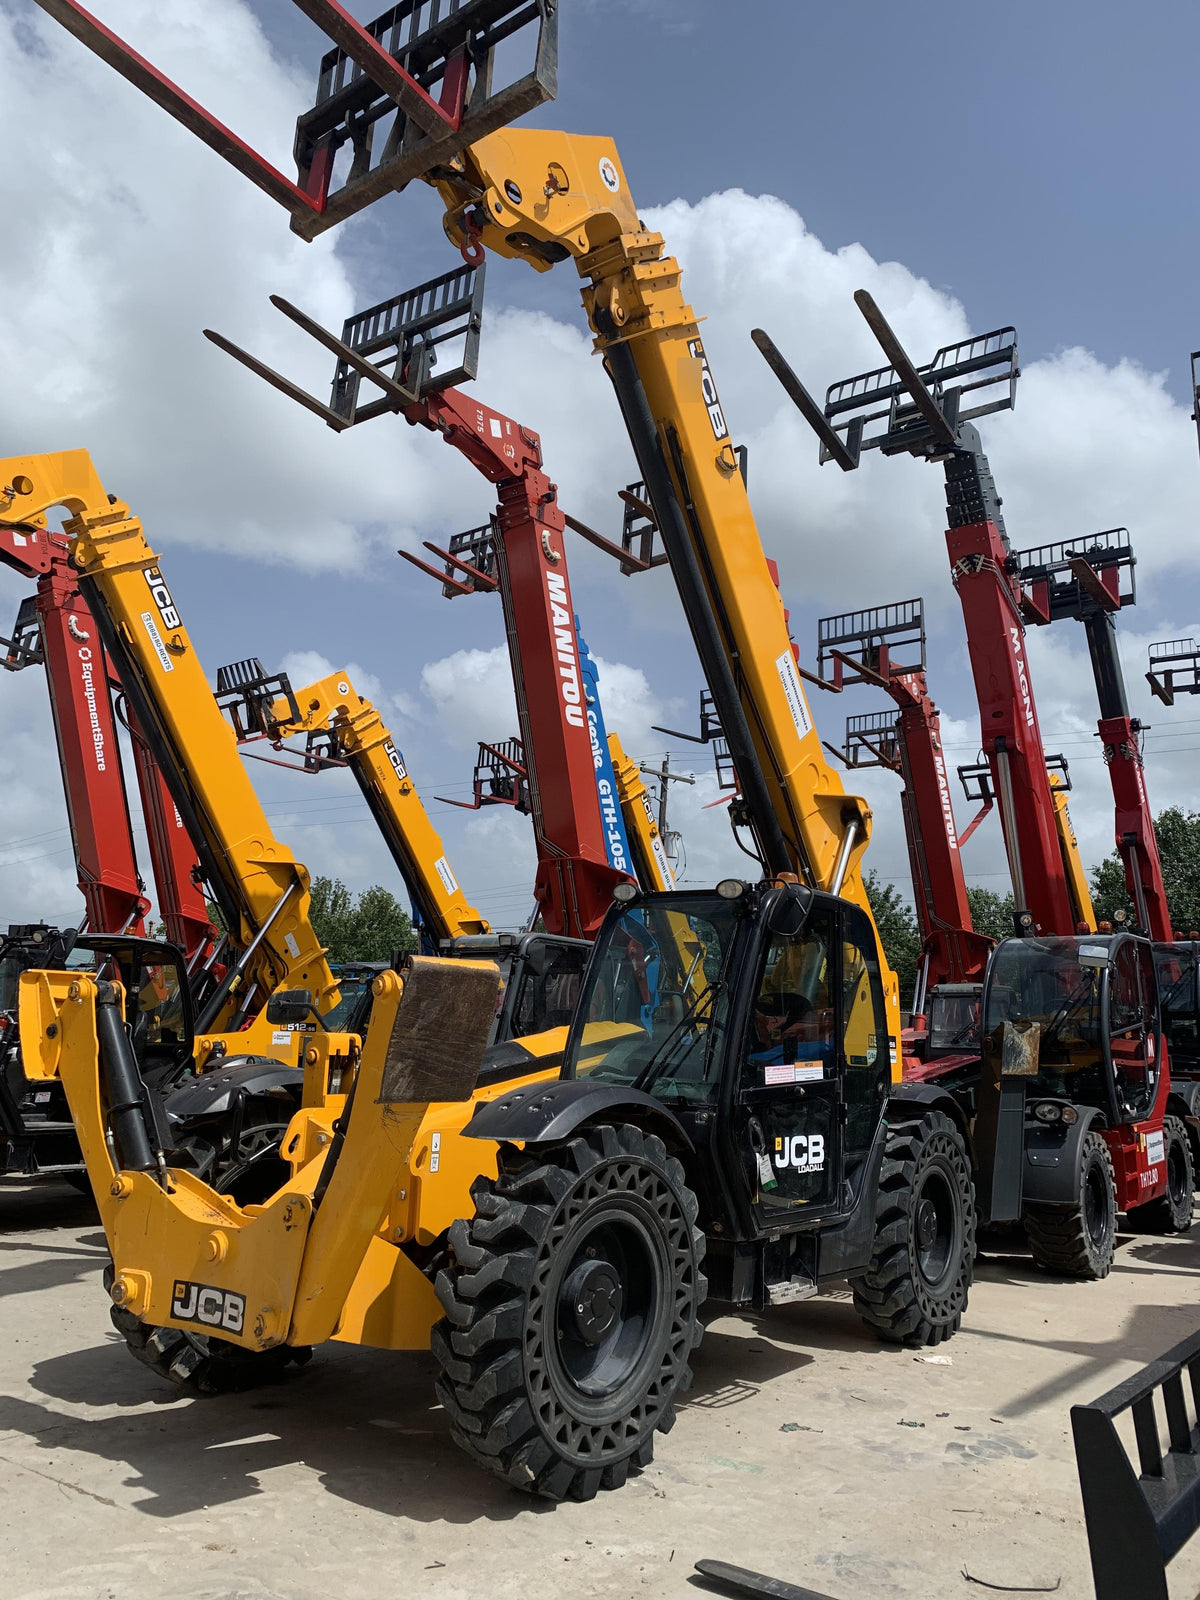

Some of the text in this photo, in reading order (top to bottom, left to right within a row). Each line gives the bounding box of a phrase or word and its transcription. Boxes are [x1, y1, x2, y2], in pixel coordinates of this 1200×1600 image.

[476, 409, 484, 433] 7975
[144, 569, 180, 629] JCB
[546, 571, 584, 727] MANITOU
[1010, 627, 1034, 727] MAGNI
[82, 662, 106, 771] EquipmentShare
[587, 710, 603, 768] Genie
[384, 742, 406, 780] JCB
[599, 778, 627, 873] GTH-105
[641, 795, 654, 824] JCB
[935, 756, 957, 849] MANITOU
[775, 1135, 825, 1168] JCB
[798, 1164, 824, 1174] LOADALL
[173, 1286, 244, 1331] JCB
